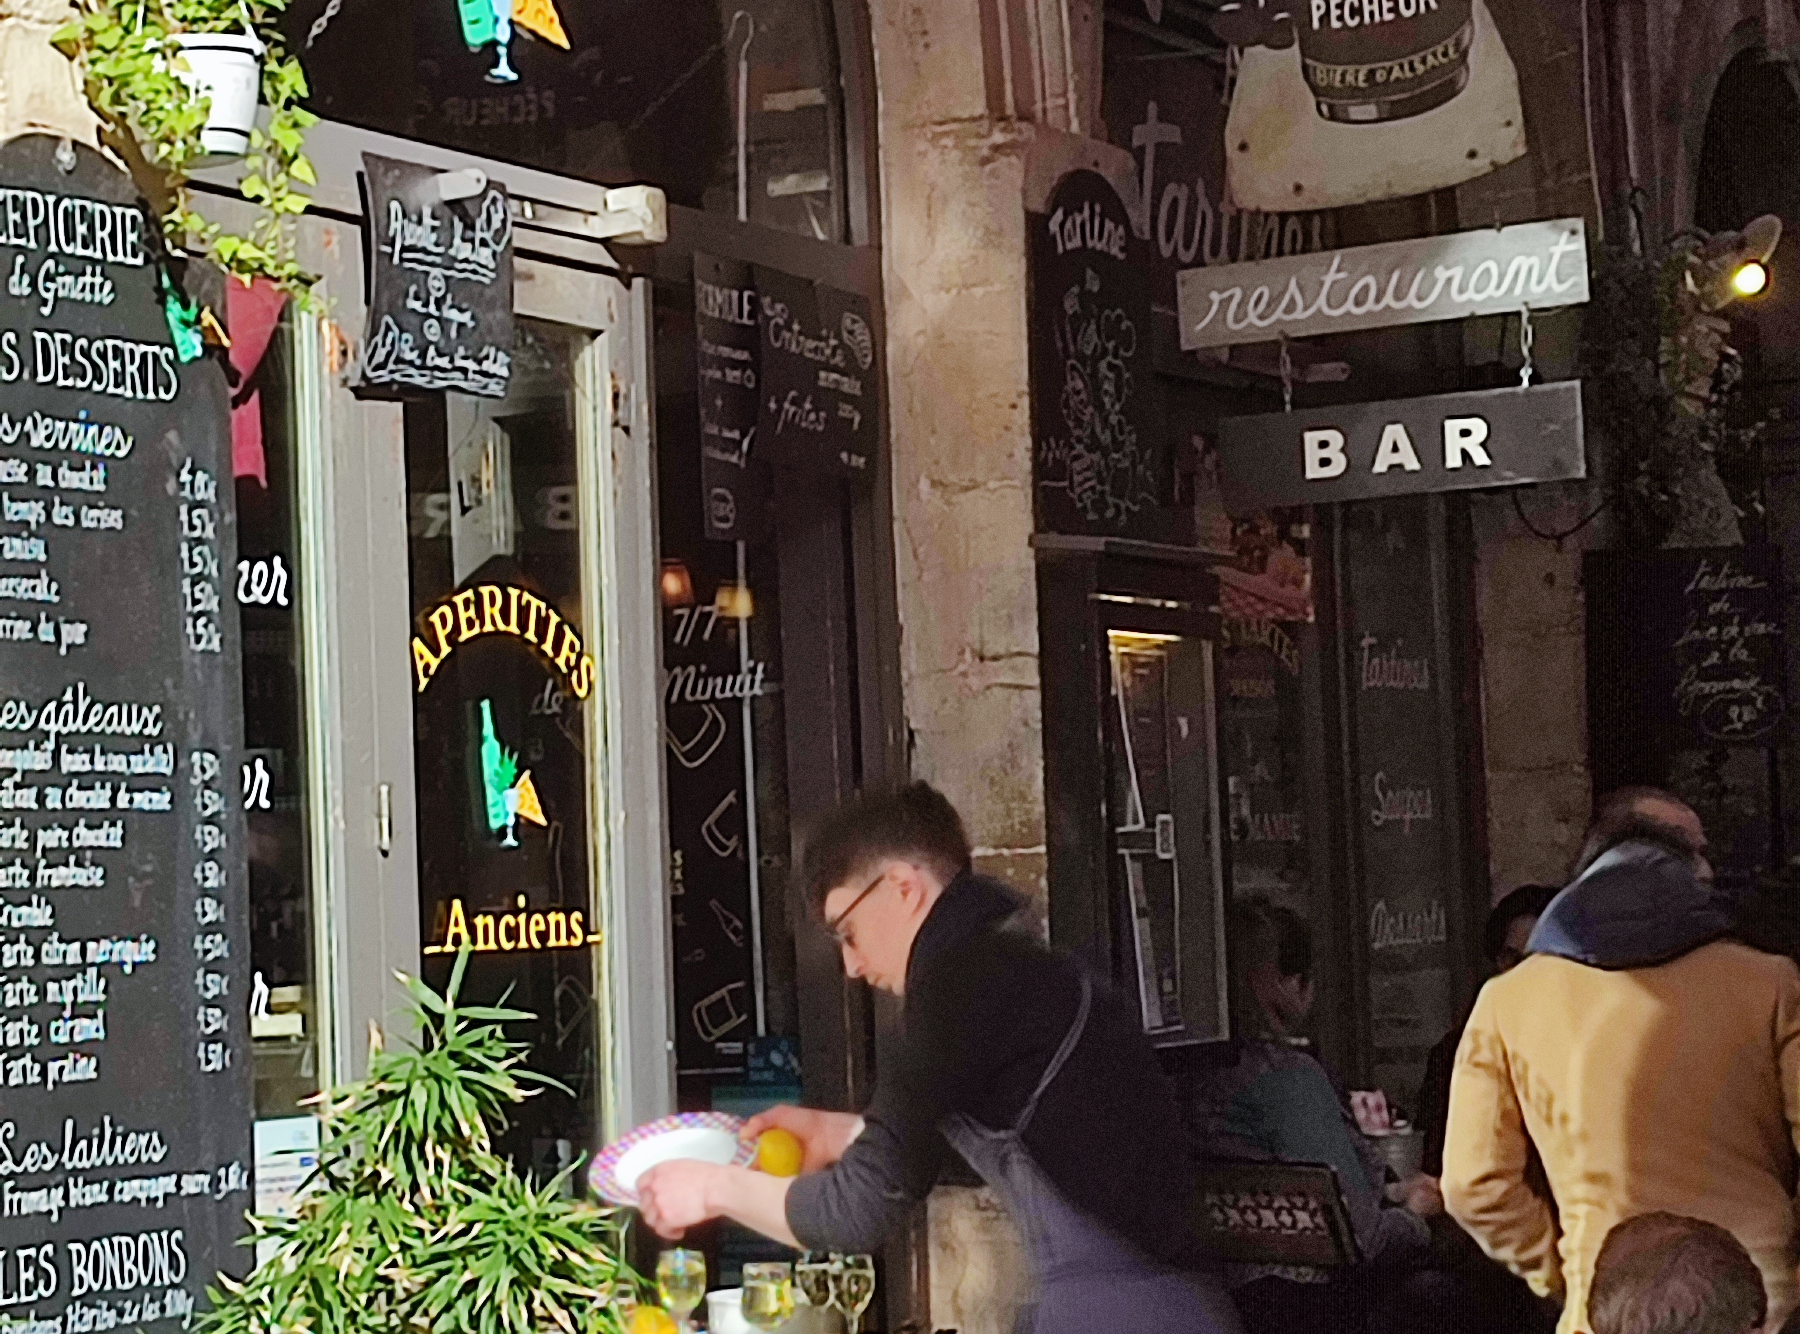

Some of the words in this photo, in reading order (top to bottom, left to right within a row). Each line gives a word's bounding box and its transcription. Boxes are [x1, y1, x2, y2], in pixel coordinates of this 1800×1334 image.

[1048, 200, 1127, 261] Tartine
[9, 254, 31, 297] de
[37, 258, 116, 317] Ginette
[1195, 231, 1580, 335] restaurant
[34, 331, 179, 401] DESSERTS
[24, 410, 134, 458] verrines
[1302, 416, 1492, 482] BAR
[411, 584, 595, 699] APERITIFS
[671, 605, 718, 646] 7/7
[668, 660, 766, 704] Minuit
[38, 681, 163, 750] gâteaux
[444, 894, 584, 954] Anciens
[0, 1243, 57, 1305] LES
[68, 1228, 187, 1296] BONBONS
